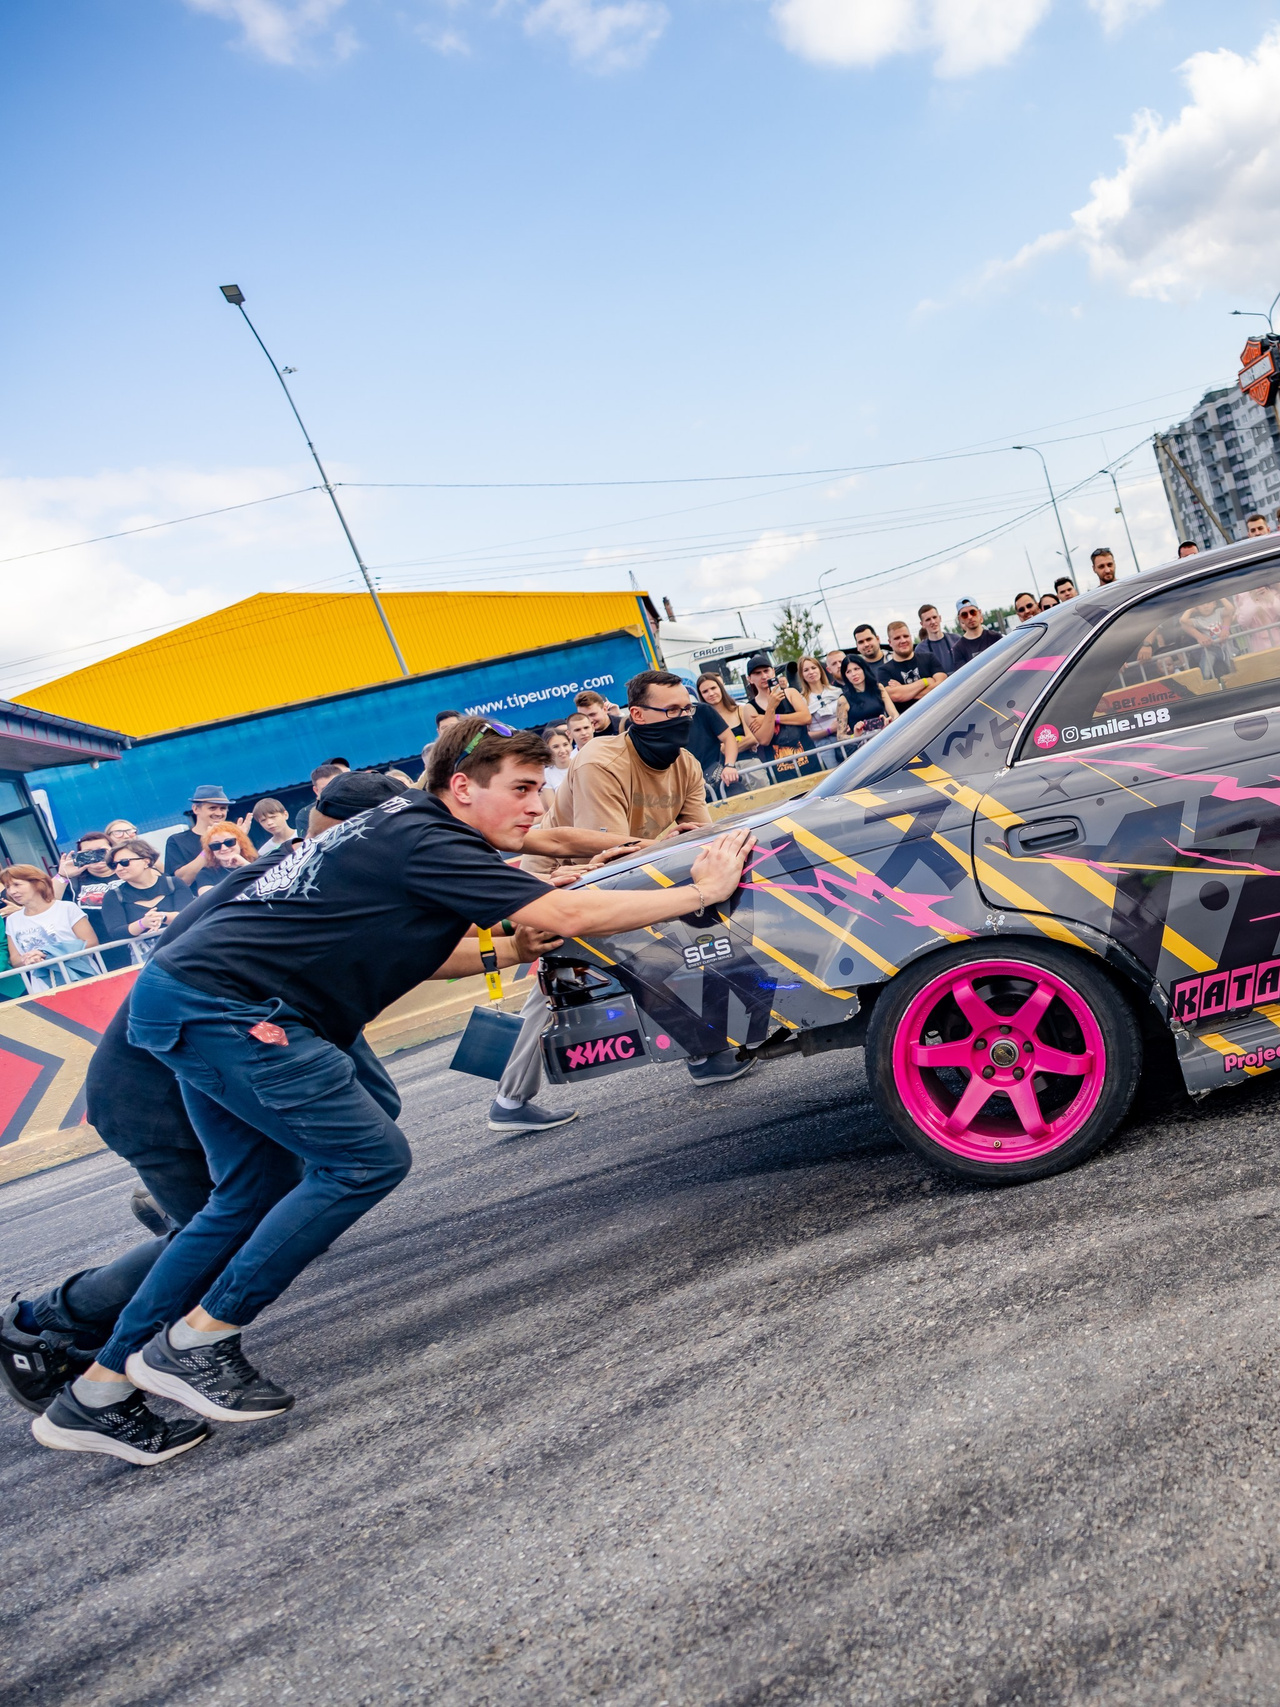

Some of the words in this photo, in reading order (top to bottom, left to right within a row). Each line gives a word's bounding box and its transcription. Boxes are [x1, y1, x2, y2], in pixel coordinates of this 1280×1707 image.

[693, 646, 725, 660] CARGO
[464, 672, 614, 717] www.tipeurope.com
[1080, 707, 1171, 741] smile.198
[684, 938, 731, 964] SCS
